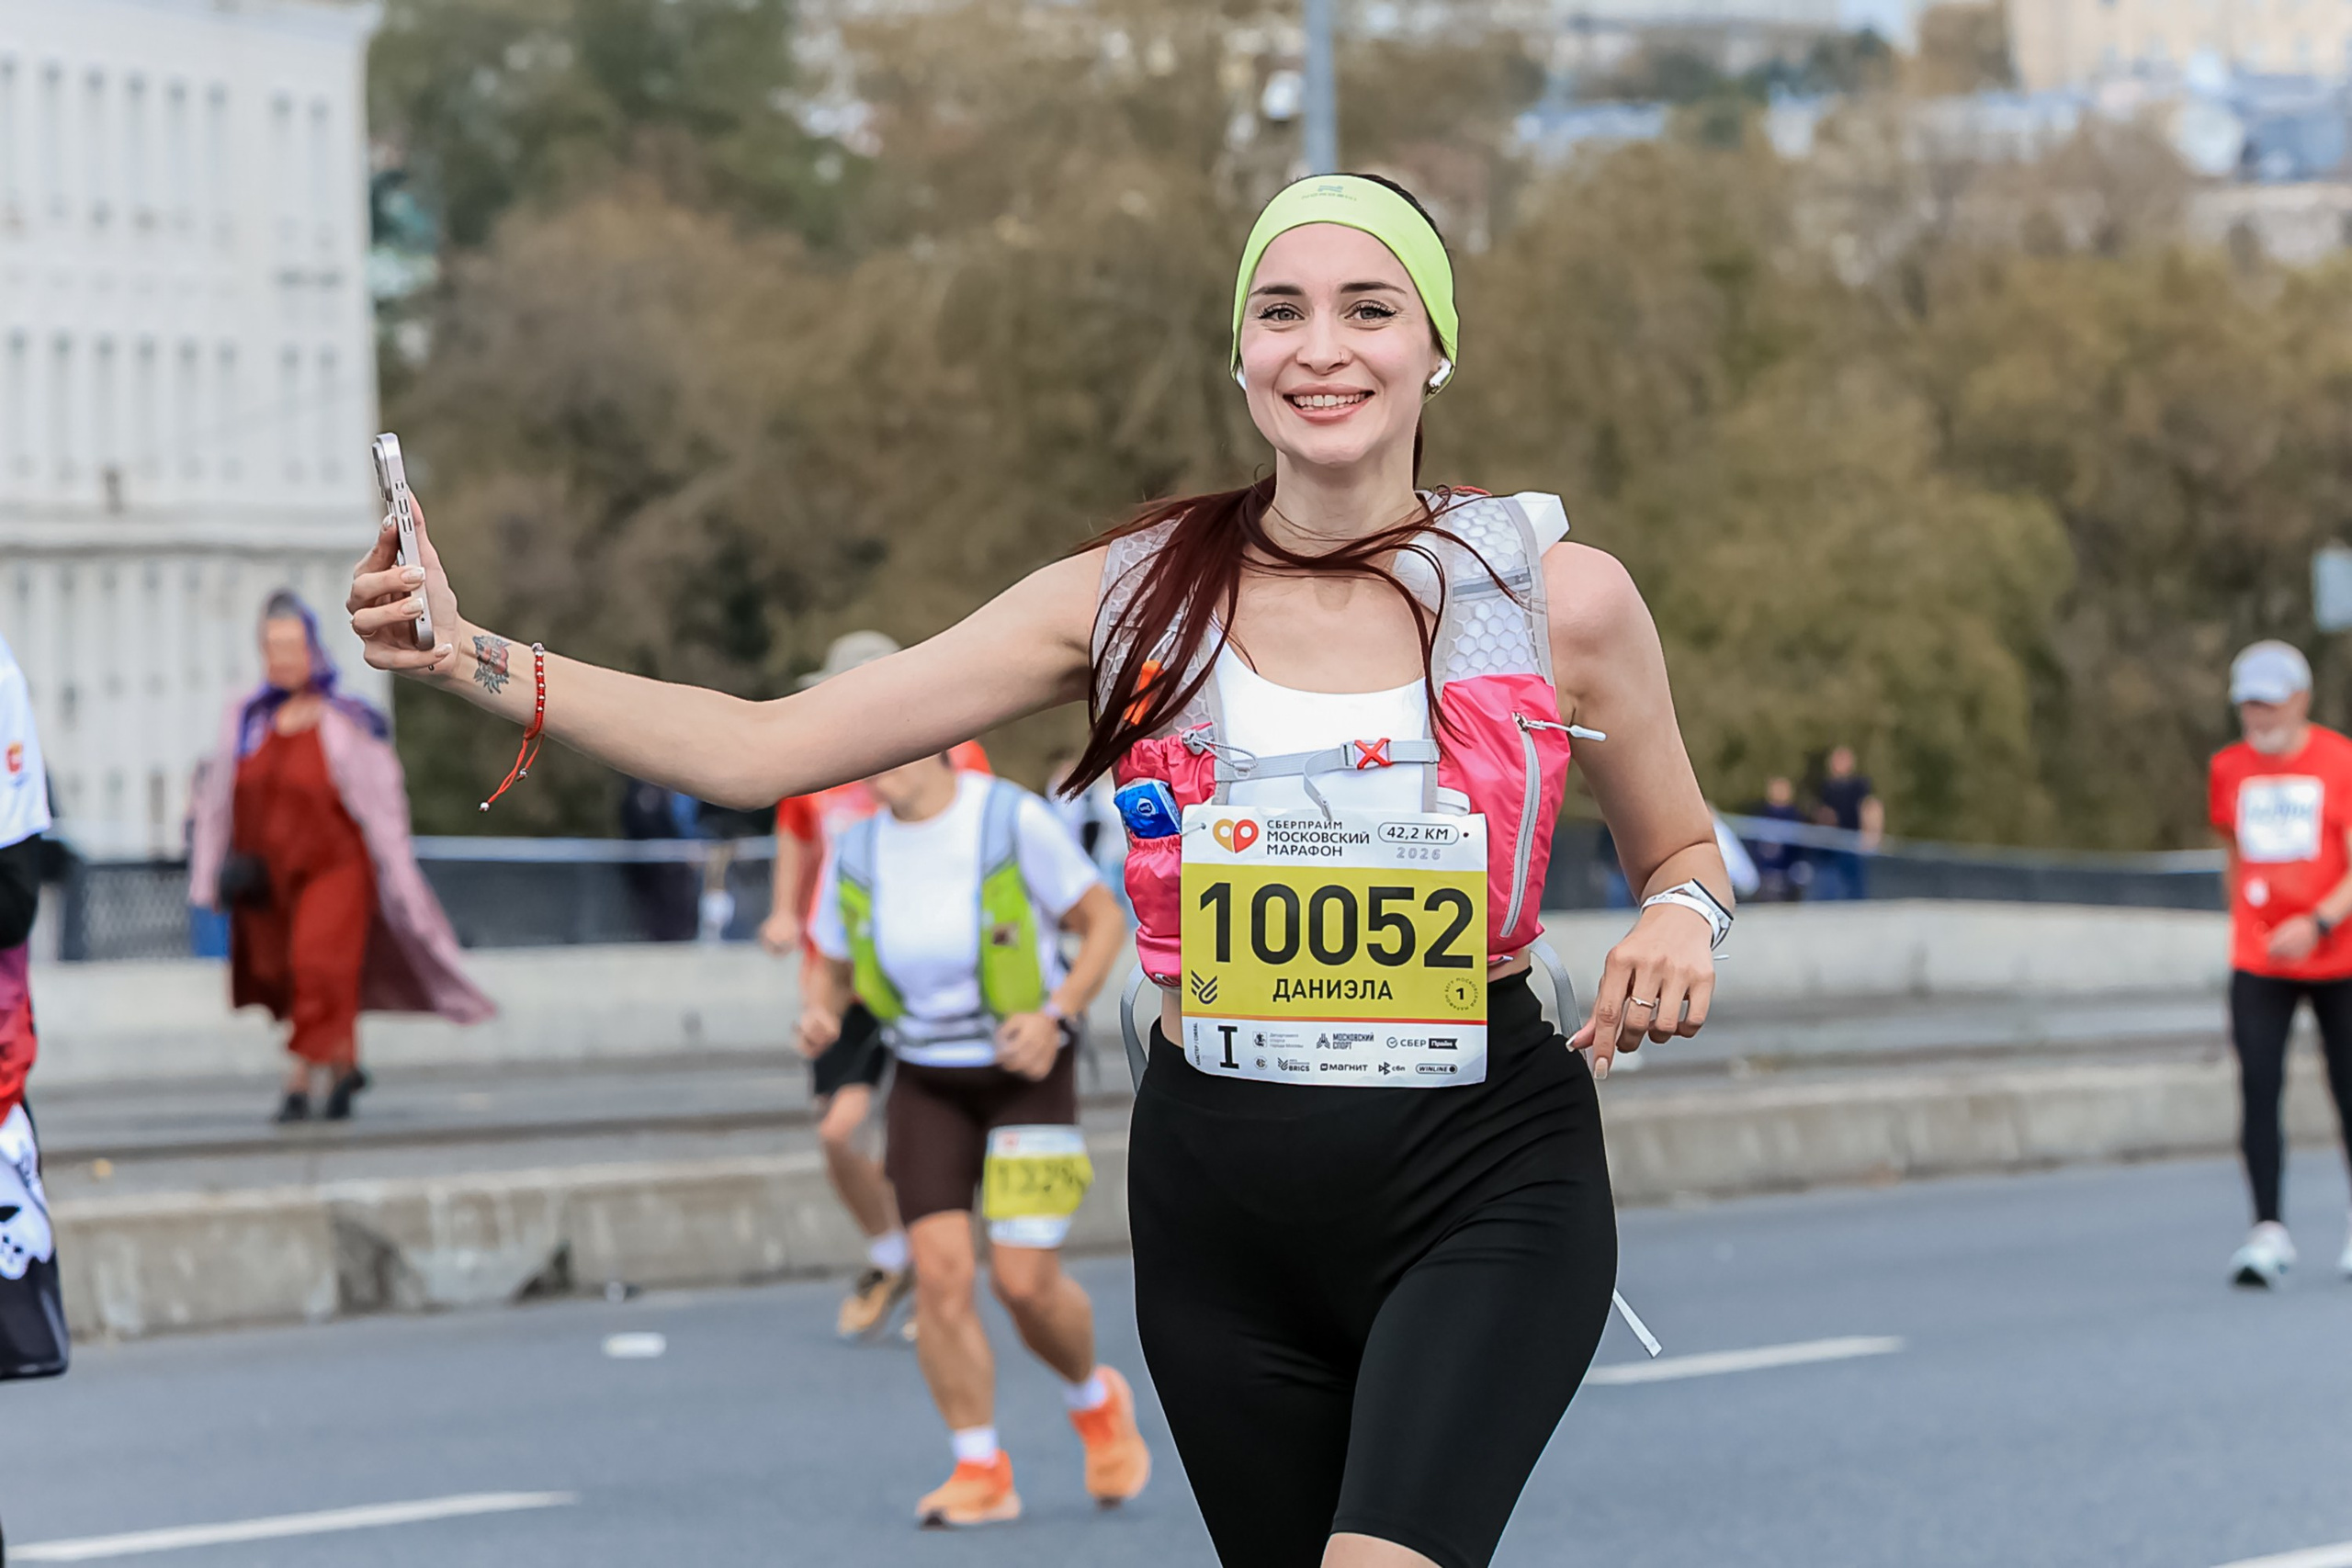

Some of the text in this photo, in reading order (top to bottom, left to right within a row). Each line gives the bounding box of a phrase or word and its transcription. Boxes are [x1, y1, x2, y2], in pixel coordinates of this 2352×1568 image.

[1267, 830, 1370, 844] МОСКОВСКИЙ
[1386, 827, 1449, 840] 42,2 КМ
[1267, 844, 1342, 857] МАРАФОН
[1396, 847, 1441, 861] 2026
[1199, 882, 1474, 969] 10052
[1272, 978, 1393, 1003] ДАНИЭЛА
[1455, 987, 1464, 1000] 1
[1332, 1032, 1374, 1042] МОСКОВСКИЙ
[1400, 1039, 1427, 1047] СБЕР
[1217, 1025, 1239, 1069] I
[1333, 1042, 1352, 1050] СПОРТ
